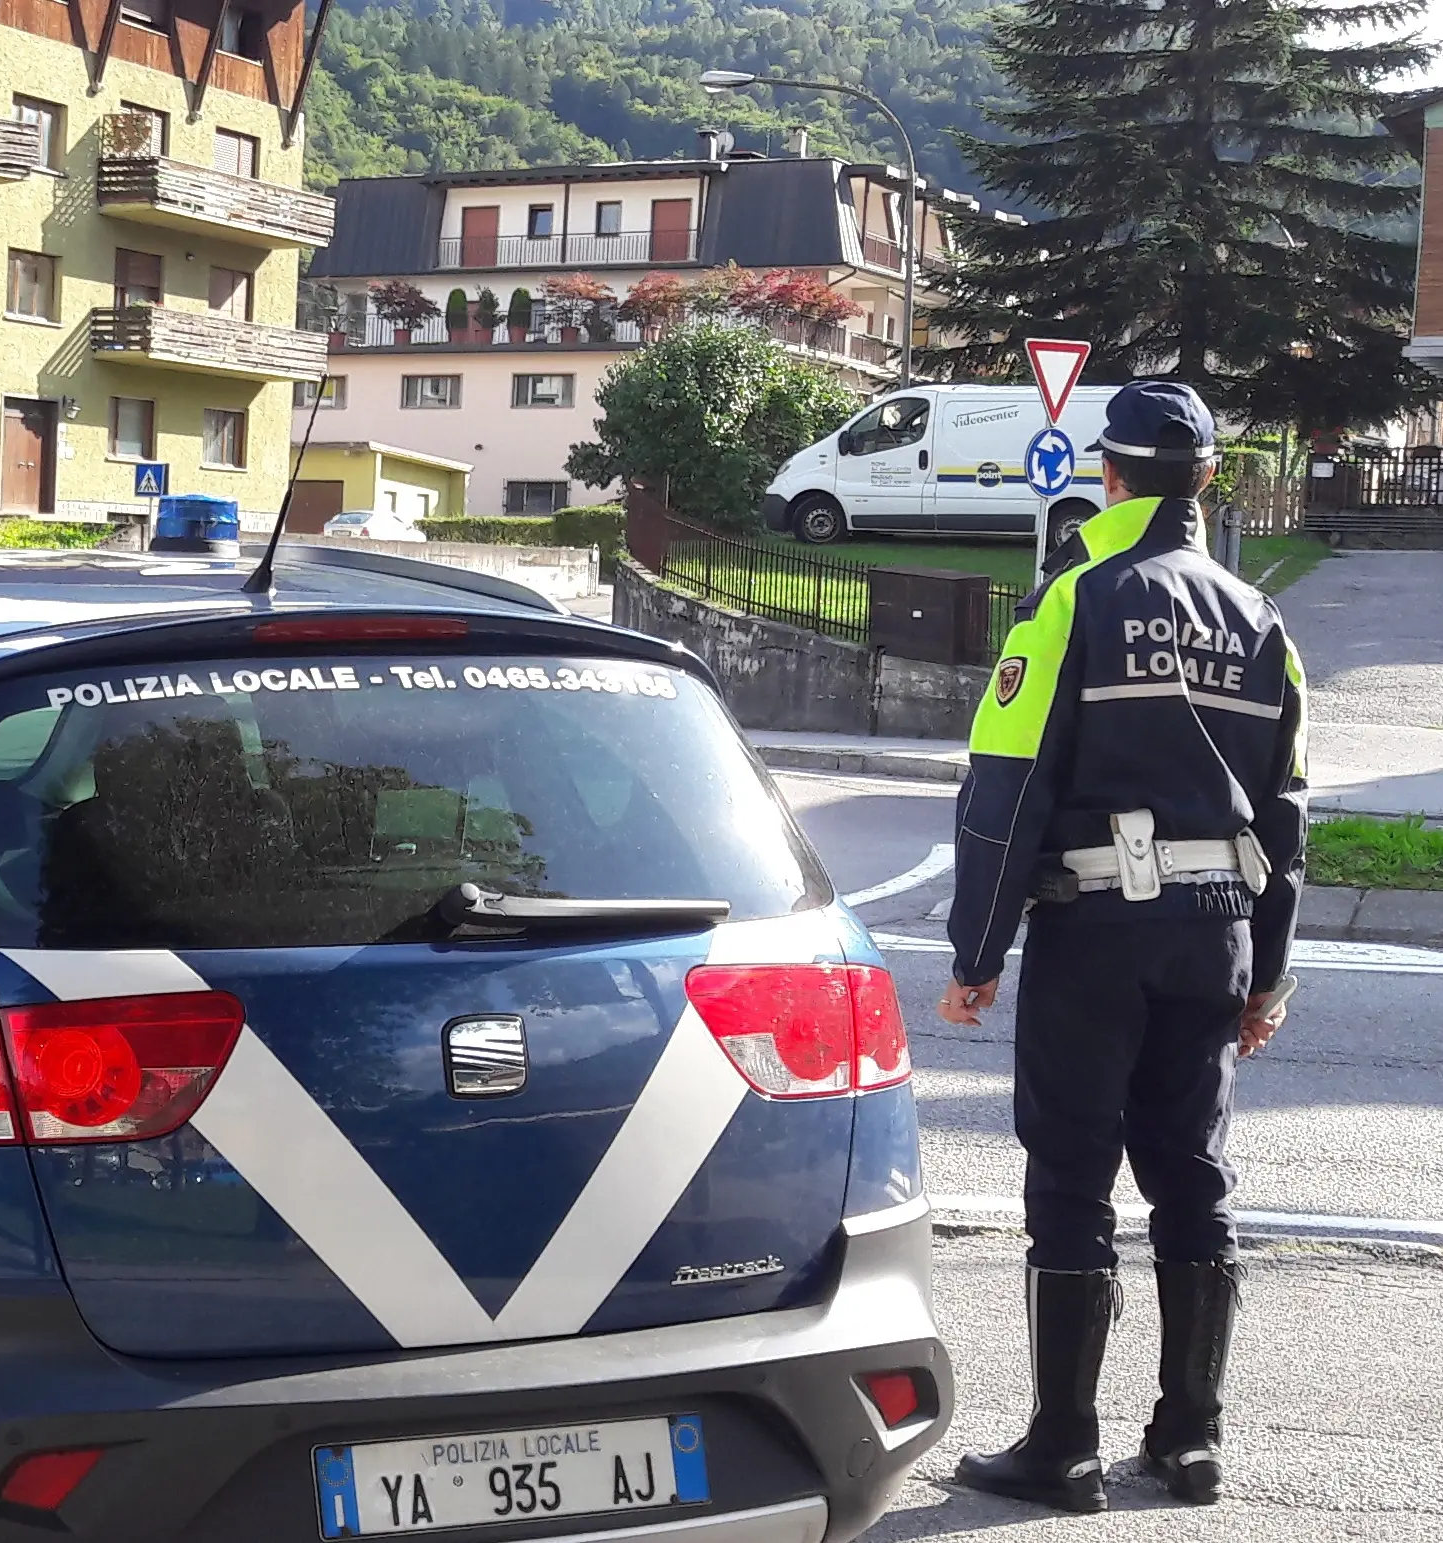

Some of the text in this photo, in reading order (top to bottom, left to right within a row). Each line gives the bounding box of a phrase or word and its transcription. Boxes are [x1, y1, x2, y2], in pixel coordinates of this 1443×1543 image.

[952, 411, 1020, 428] Videocenter
[977, 470, 1002, 480] point
[1124, 618, 1246, 657] POIZIA
[47, 673, 204, 709] POLIZIA
[209, 667, 360, 695] LOCALE
[389, 666, 457, 690] Tel.
[1126, 651, 1244, 691] LOALE
[432, 1430, 602, 1466] POLIZIA LOCALE
[381, 1473, 433, 1527] YA
[488, 1462, 561, 1516] 935
[613, 1452, 655, 1506] AJ
